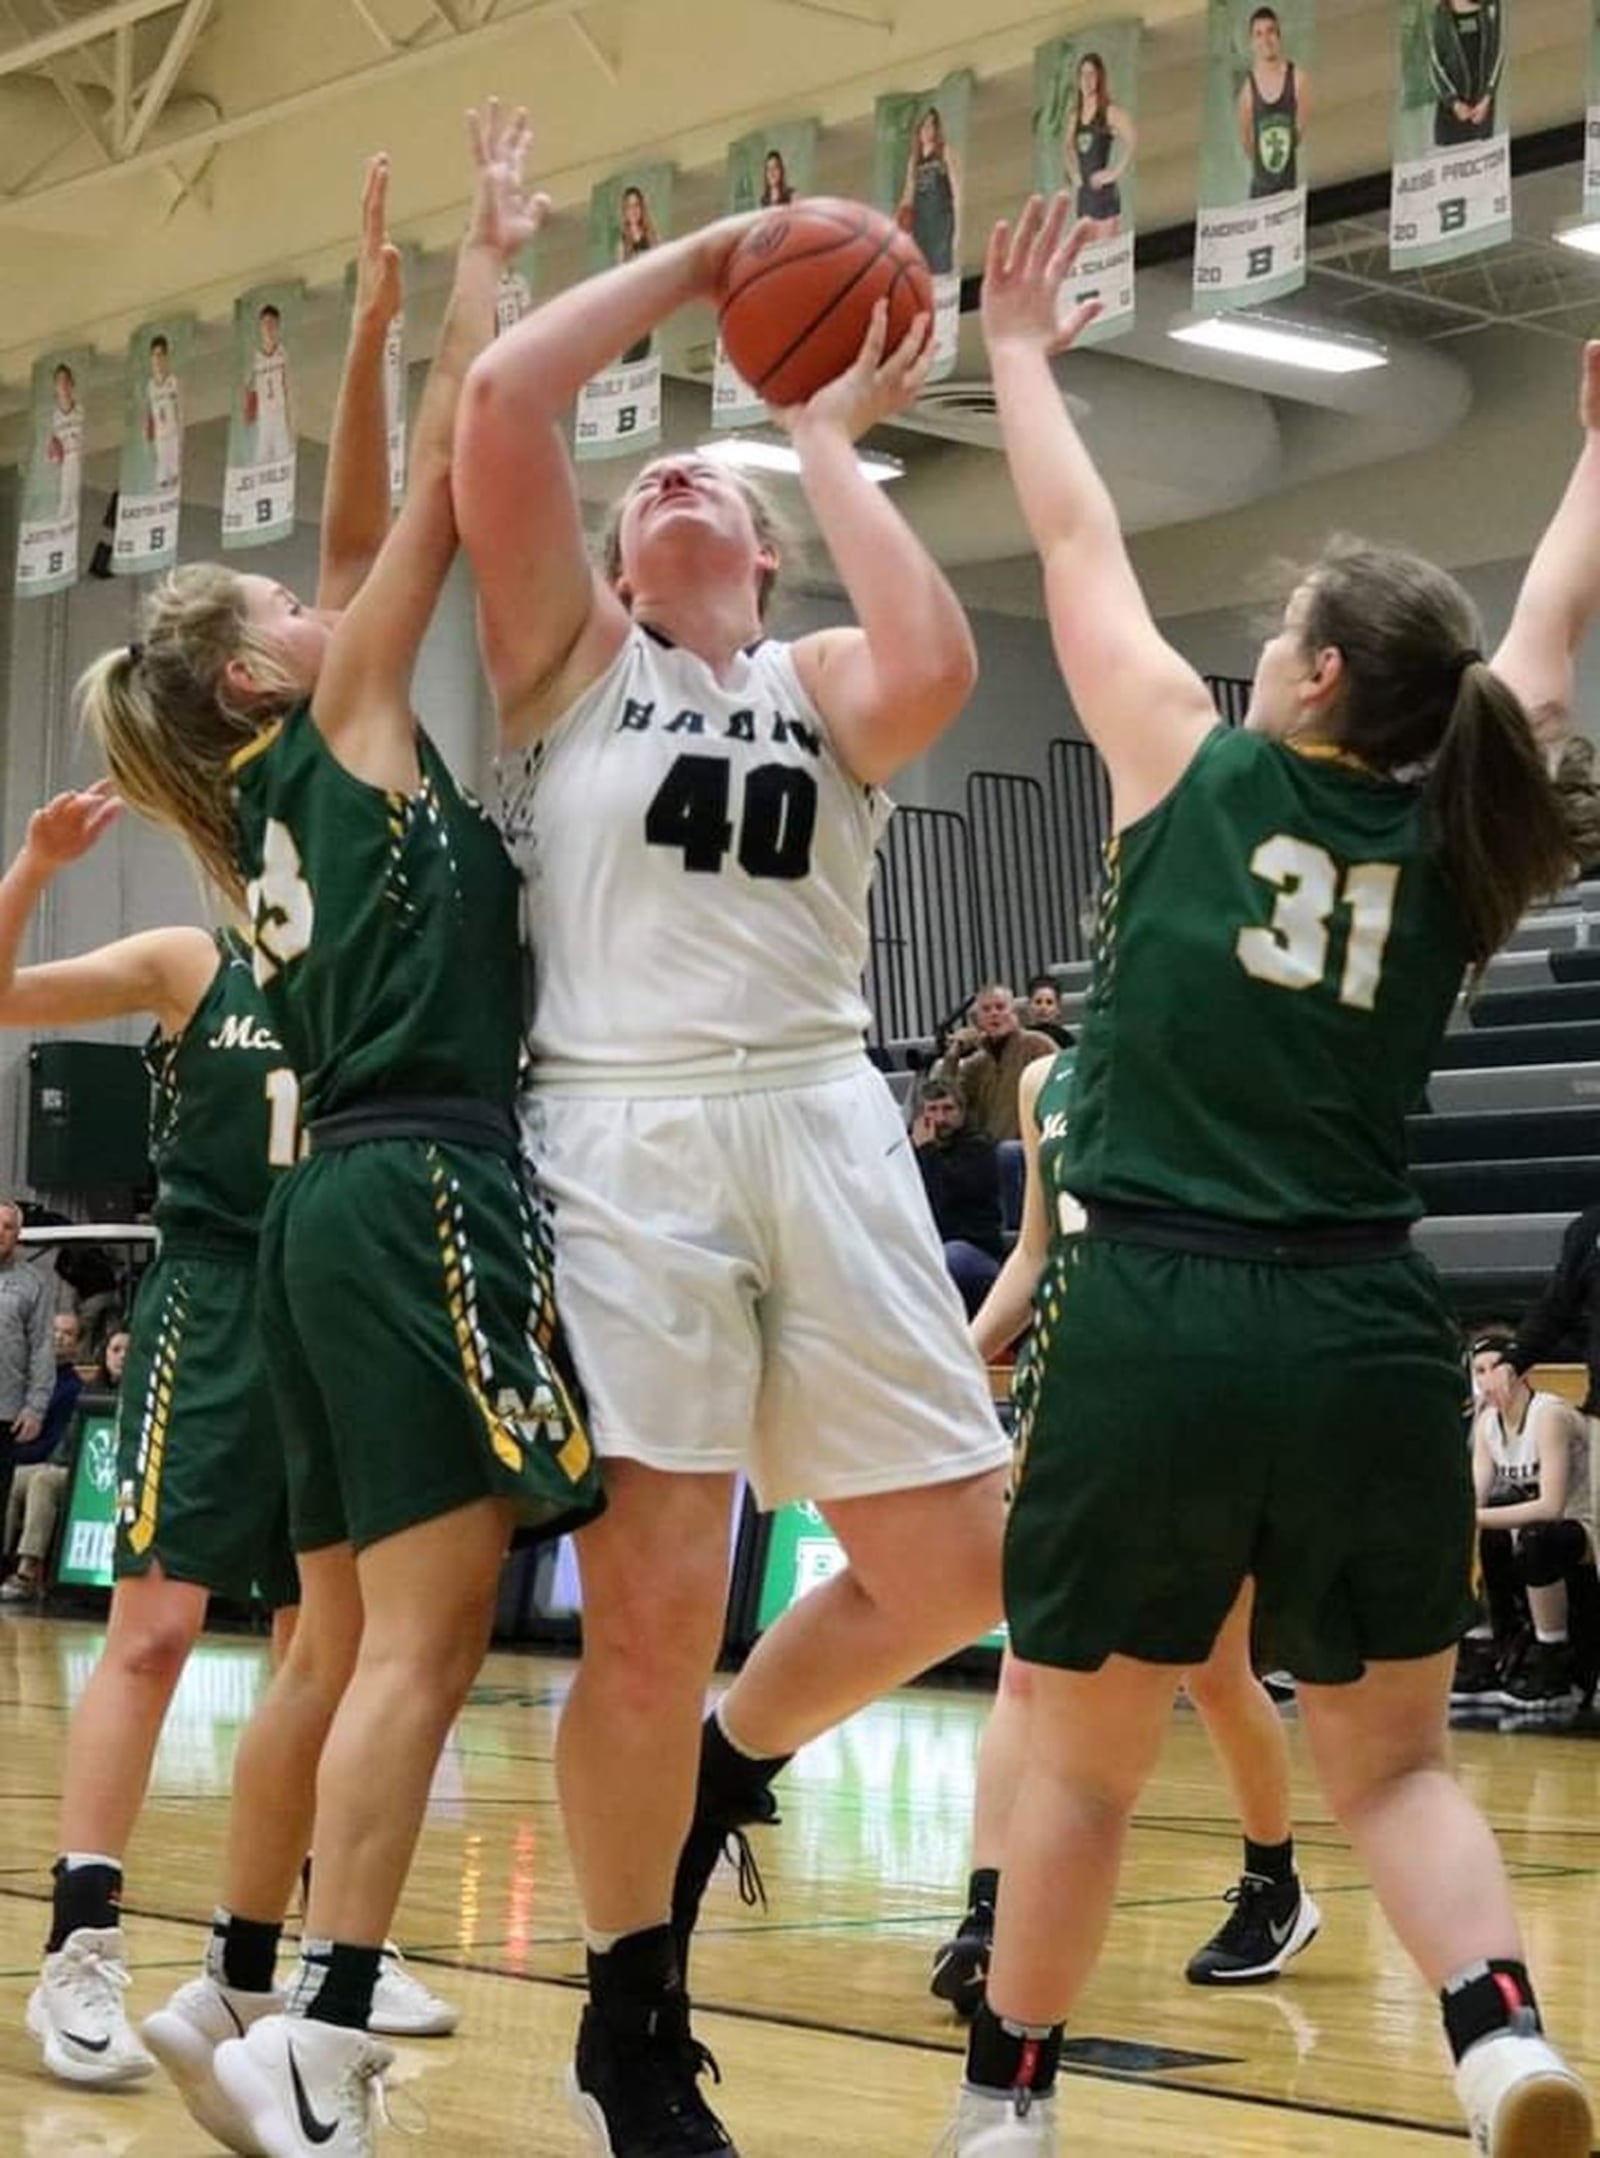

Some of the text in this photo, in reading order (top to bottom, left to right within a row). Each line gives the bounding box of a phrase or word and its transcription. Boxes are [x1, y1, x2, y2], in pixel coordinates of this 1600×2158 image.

[1438, 197, 1466, 233] B
[1196, 266, 1222, 284] 20
[1247, 245, 1274, 278] B
[616, 406, 637, 433] B
[256, 498, 272, 523] B
[150, 527, 165, 551] B
[48, 551, 63, 574] B
[645, 752, 818, 879] 40
[1236, 834, 1401, 1011] 31
[208, 1013, 283, 1050] Mc
[265, 1067, 310, 1168] 1
